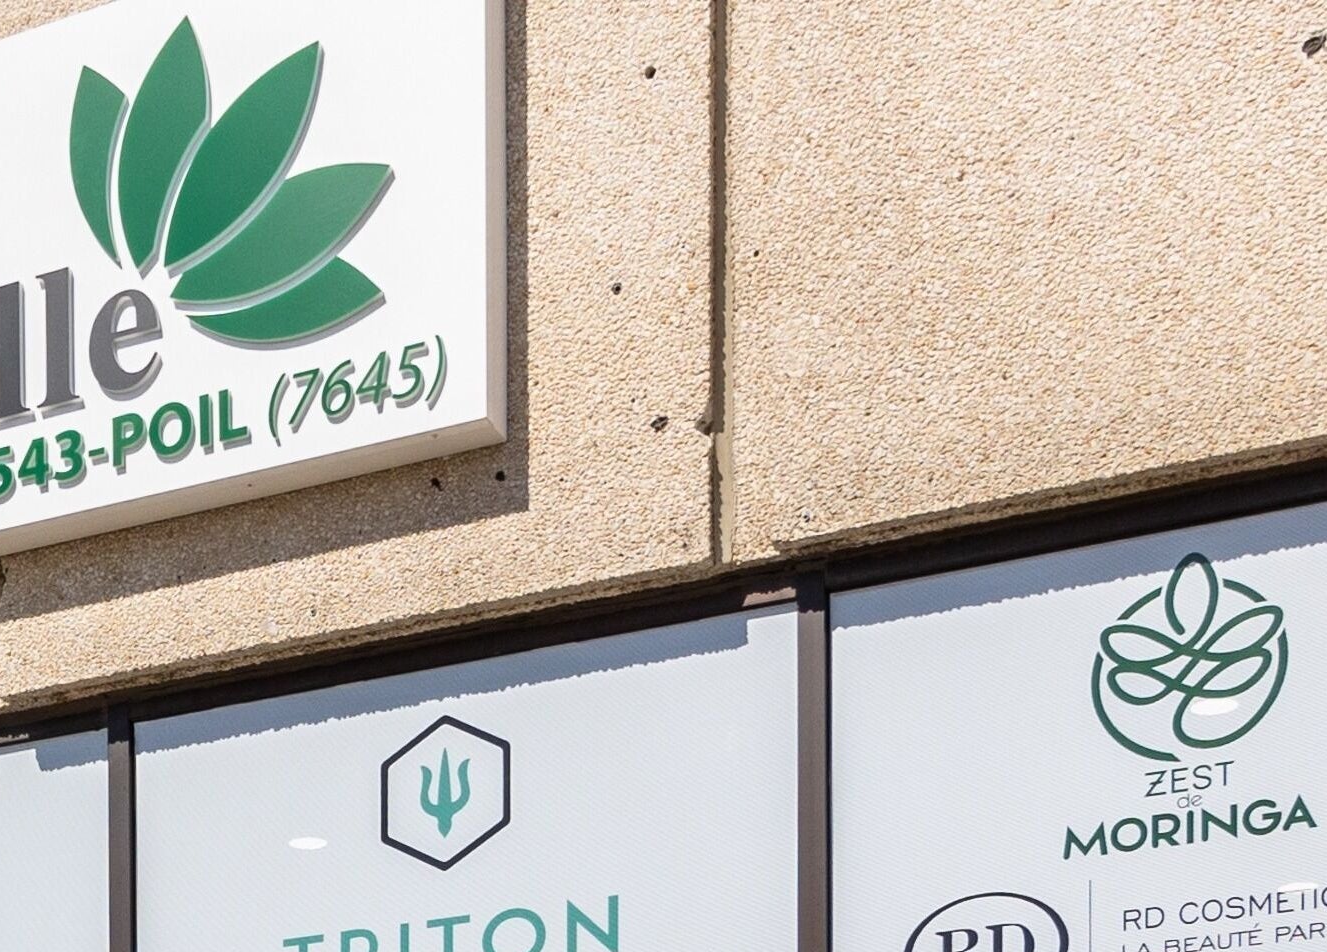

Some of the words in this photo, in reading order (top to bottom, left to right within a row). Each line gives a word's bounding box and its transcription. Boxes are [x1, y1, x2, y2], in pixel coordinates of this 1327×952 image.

[269, 334, 449, 446] (7645)
[1144, 760, 1235, 797] ZEST
[1177, 792, 1203, 809] de
[1063, 794, 1318, 860] MORINGA
[1123, 906, 1165, 932] RD
[1275, 922, 1326, 943] PAR
